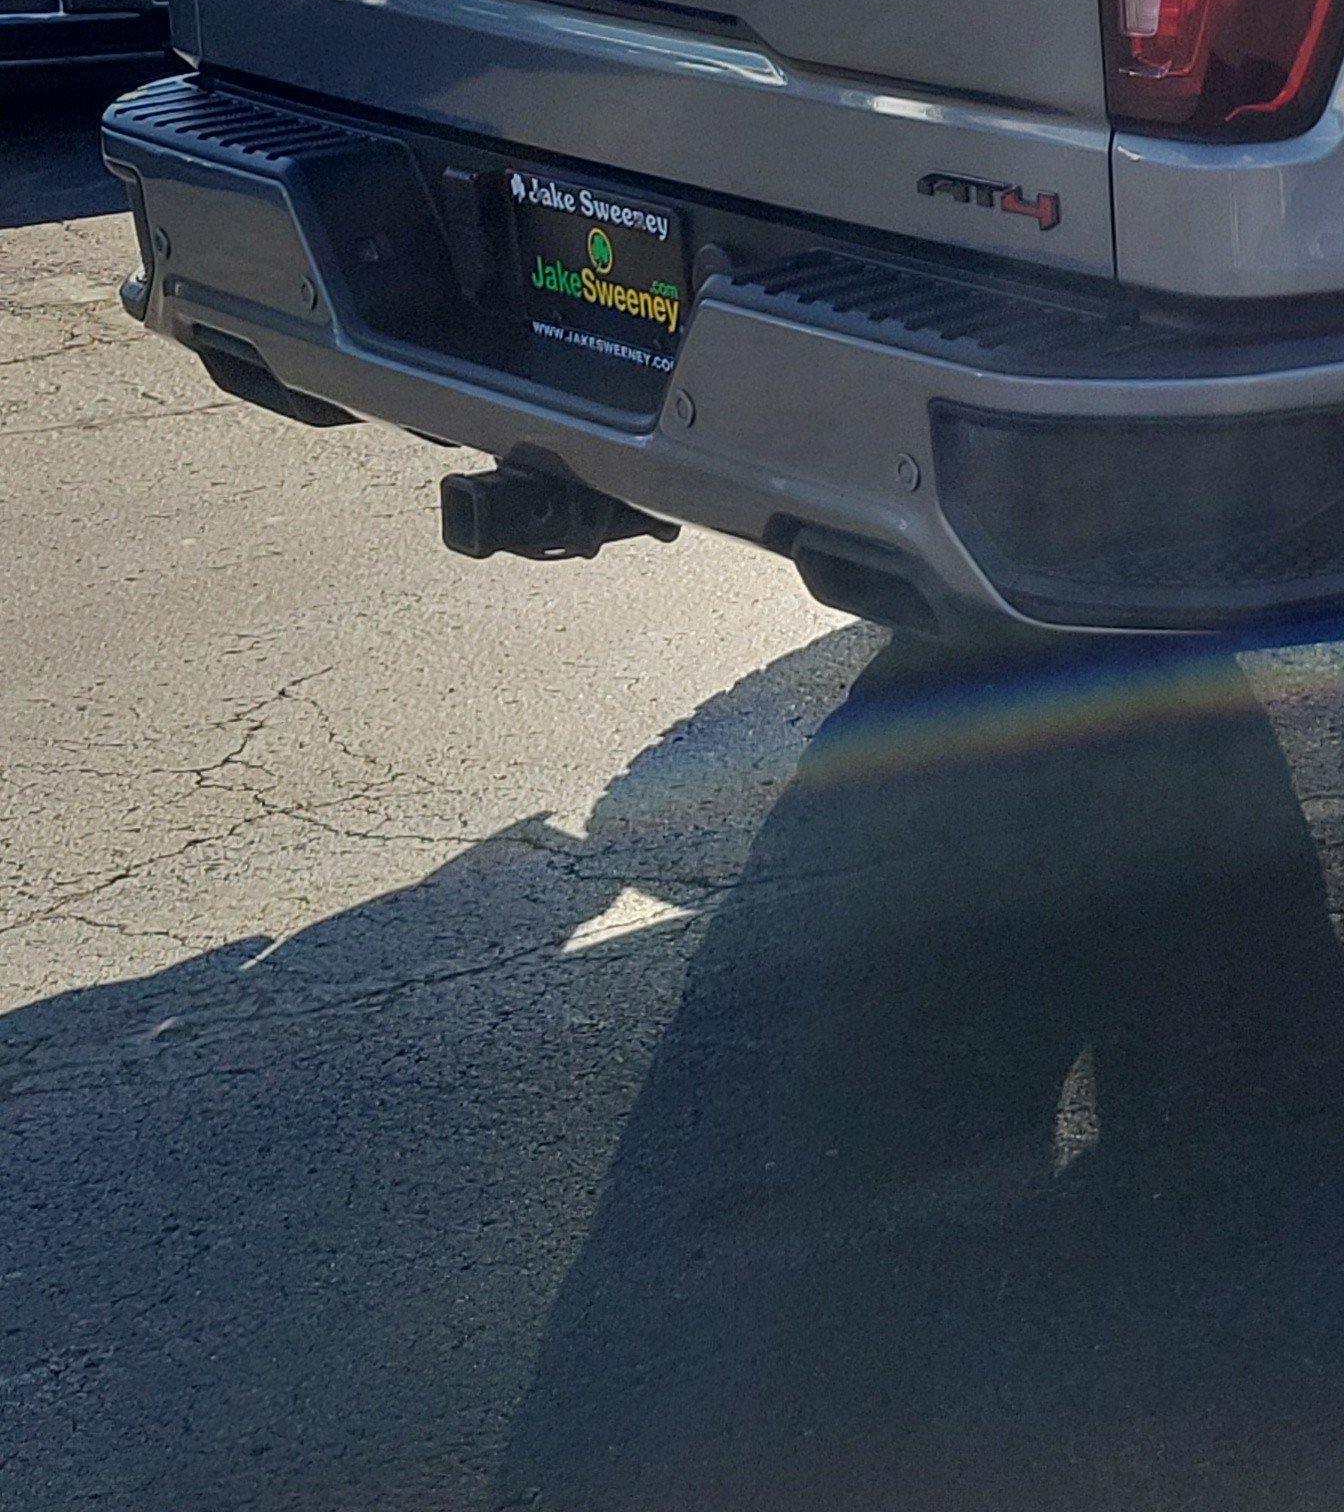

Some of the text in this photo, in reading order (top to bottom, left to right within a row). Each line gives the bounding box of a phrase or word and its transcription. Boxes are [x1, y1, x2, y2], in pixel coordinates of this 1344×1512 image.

[529, 178, 668, 240] Jake Sweeney
[916, 169, 1062, 231] AT4
[531, 255, 680, 332] JakeSweeney
